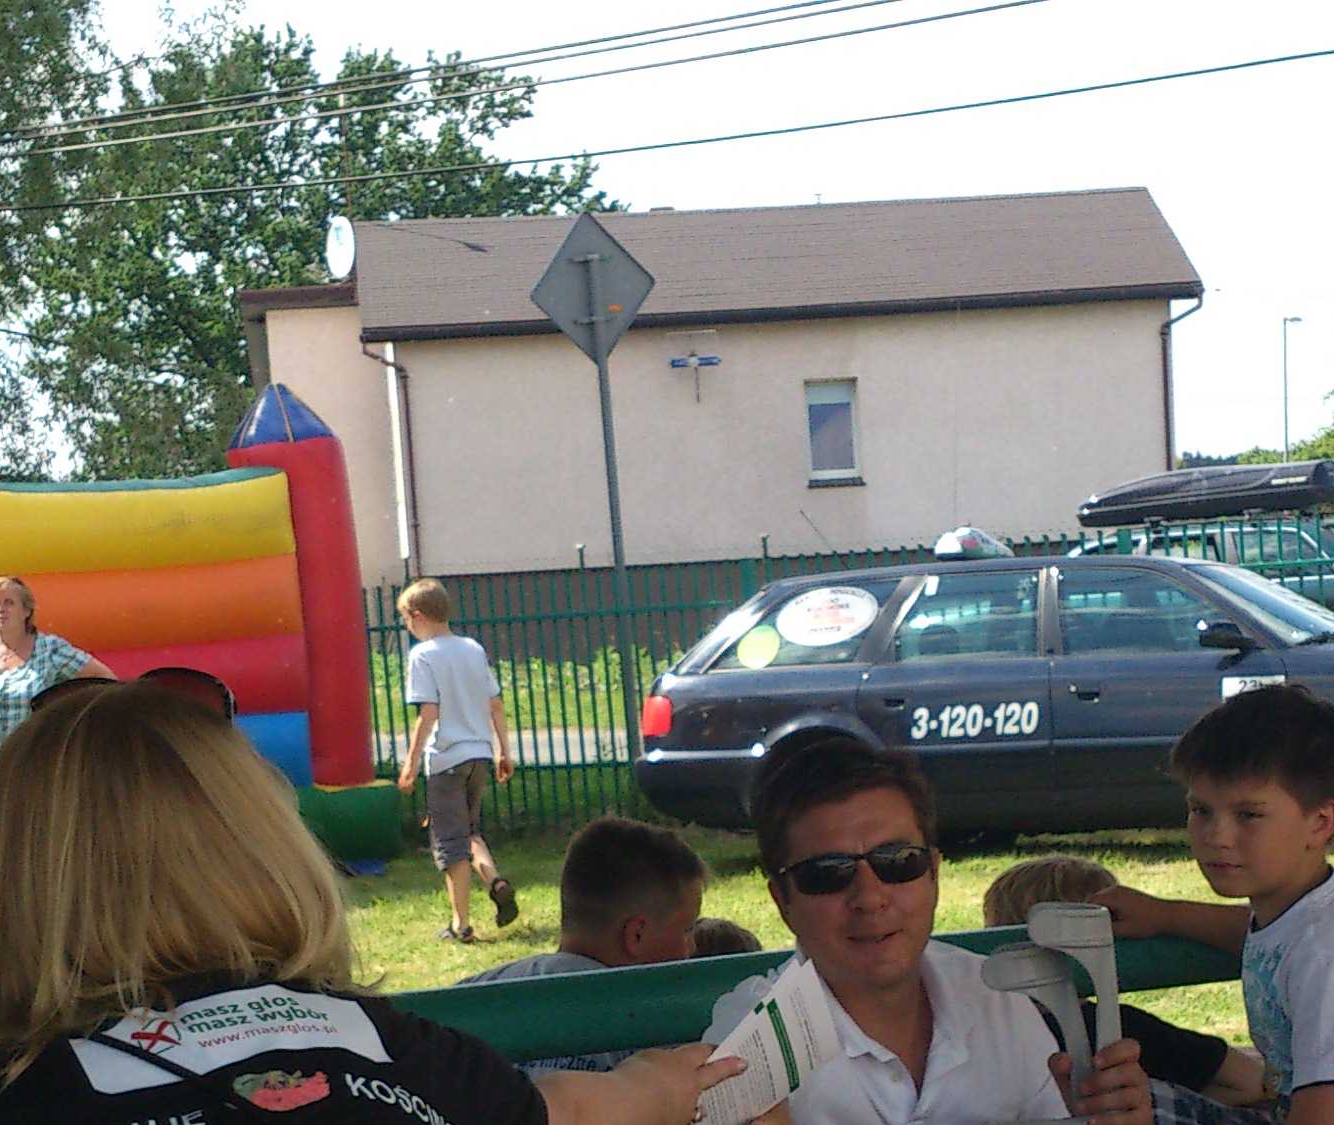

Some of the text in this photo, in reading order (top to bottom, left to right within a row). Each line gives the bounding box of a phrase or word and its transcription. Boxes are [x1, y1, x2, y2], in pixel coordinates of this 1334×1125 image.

[179, 996, 300, 1025] masz głos
[186, 1006, 329, 1034] masz wybór
